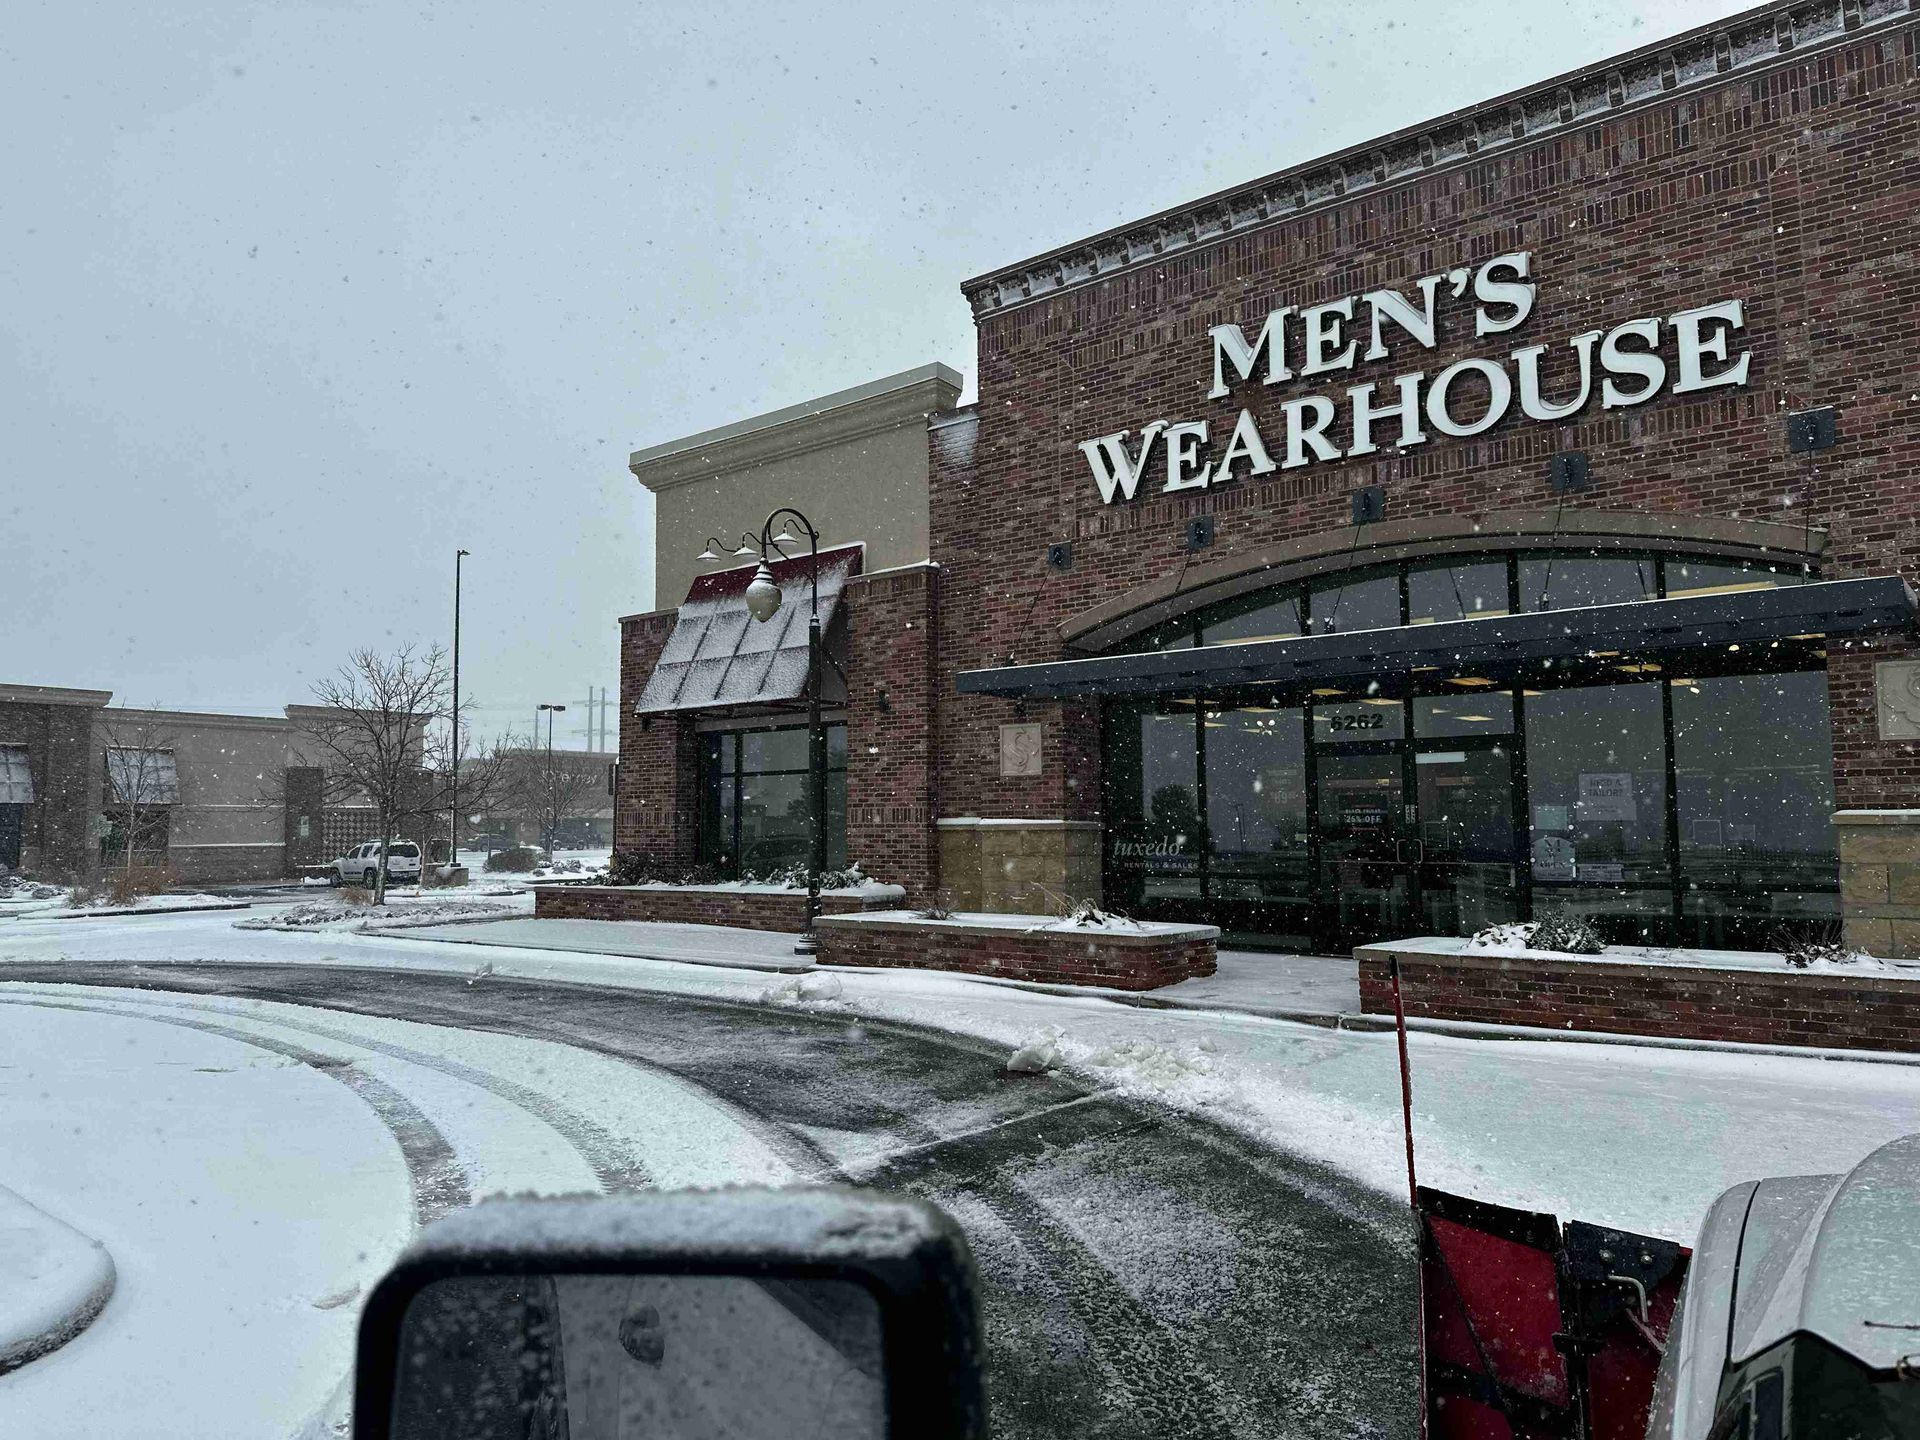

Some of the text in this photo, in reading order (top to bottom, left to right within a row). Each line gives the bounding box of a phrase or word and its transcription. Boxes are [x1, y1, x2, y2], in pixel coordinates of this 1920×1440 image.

[1207, 251, 1537, 400] MEN'S
[1079, 299, 1752, 504] WEARHOUSE
[1330, 713, 1383, 731] 6262
[1364, 815, 1382, 824] OFF
[1113, 835, 1180, 857] tuxedo
